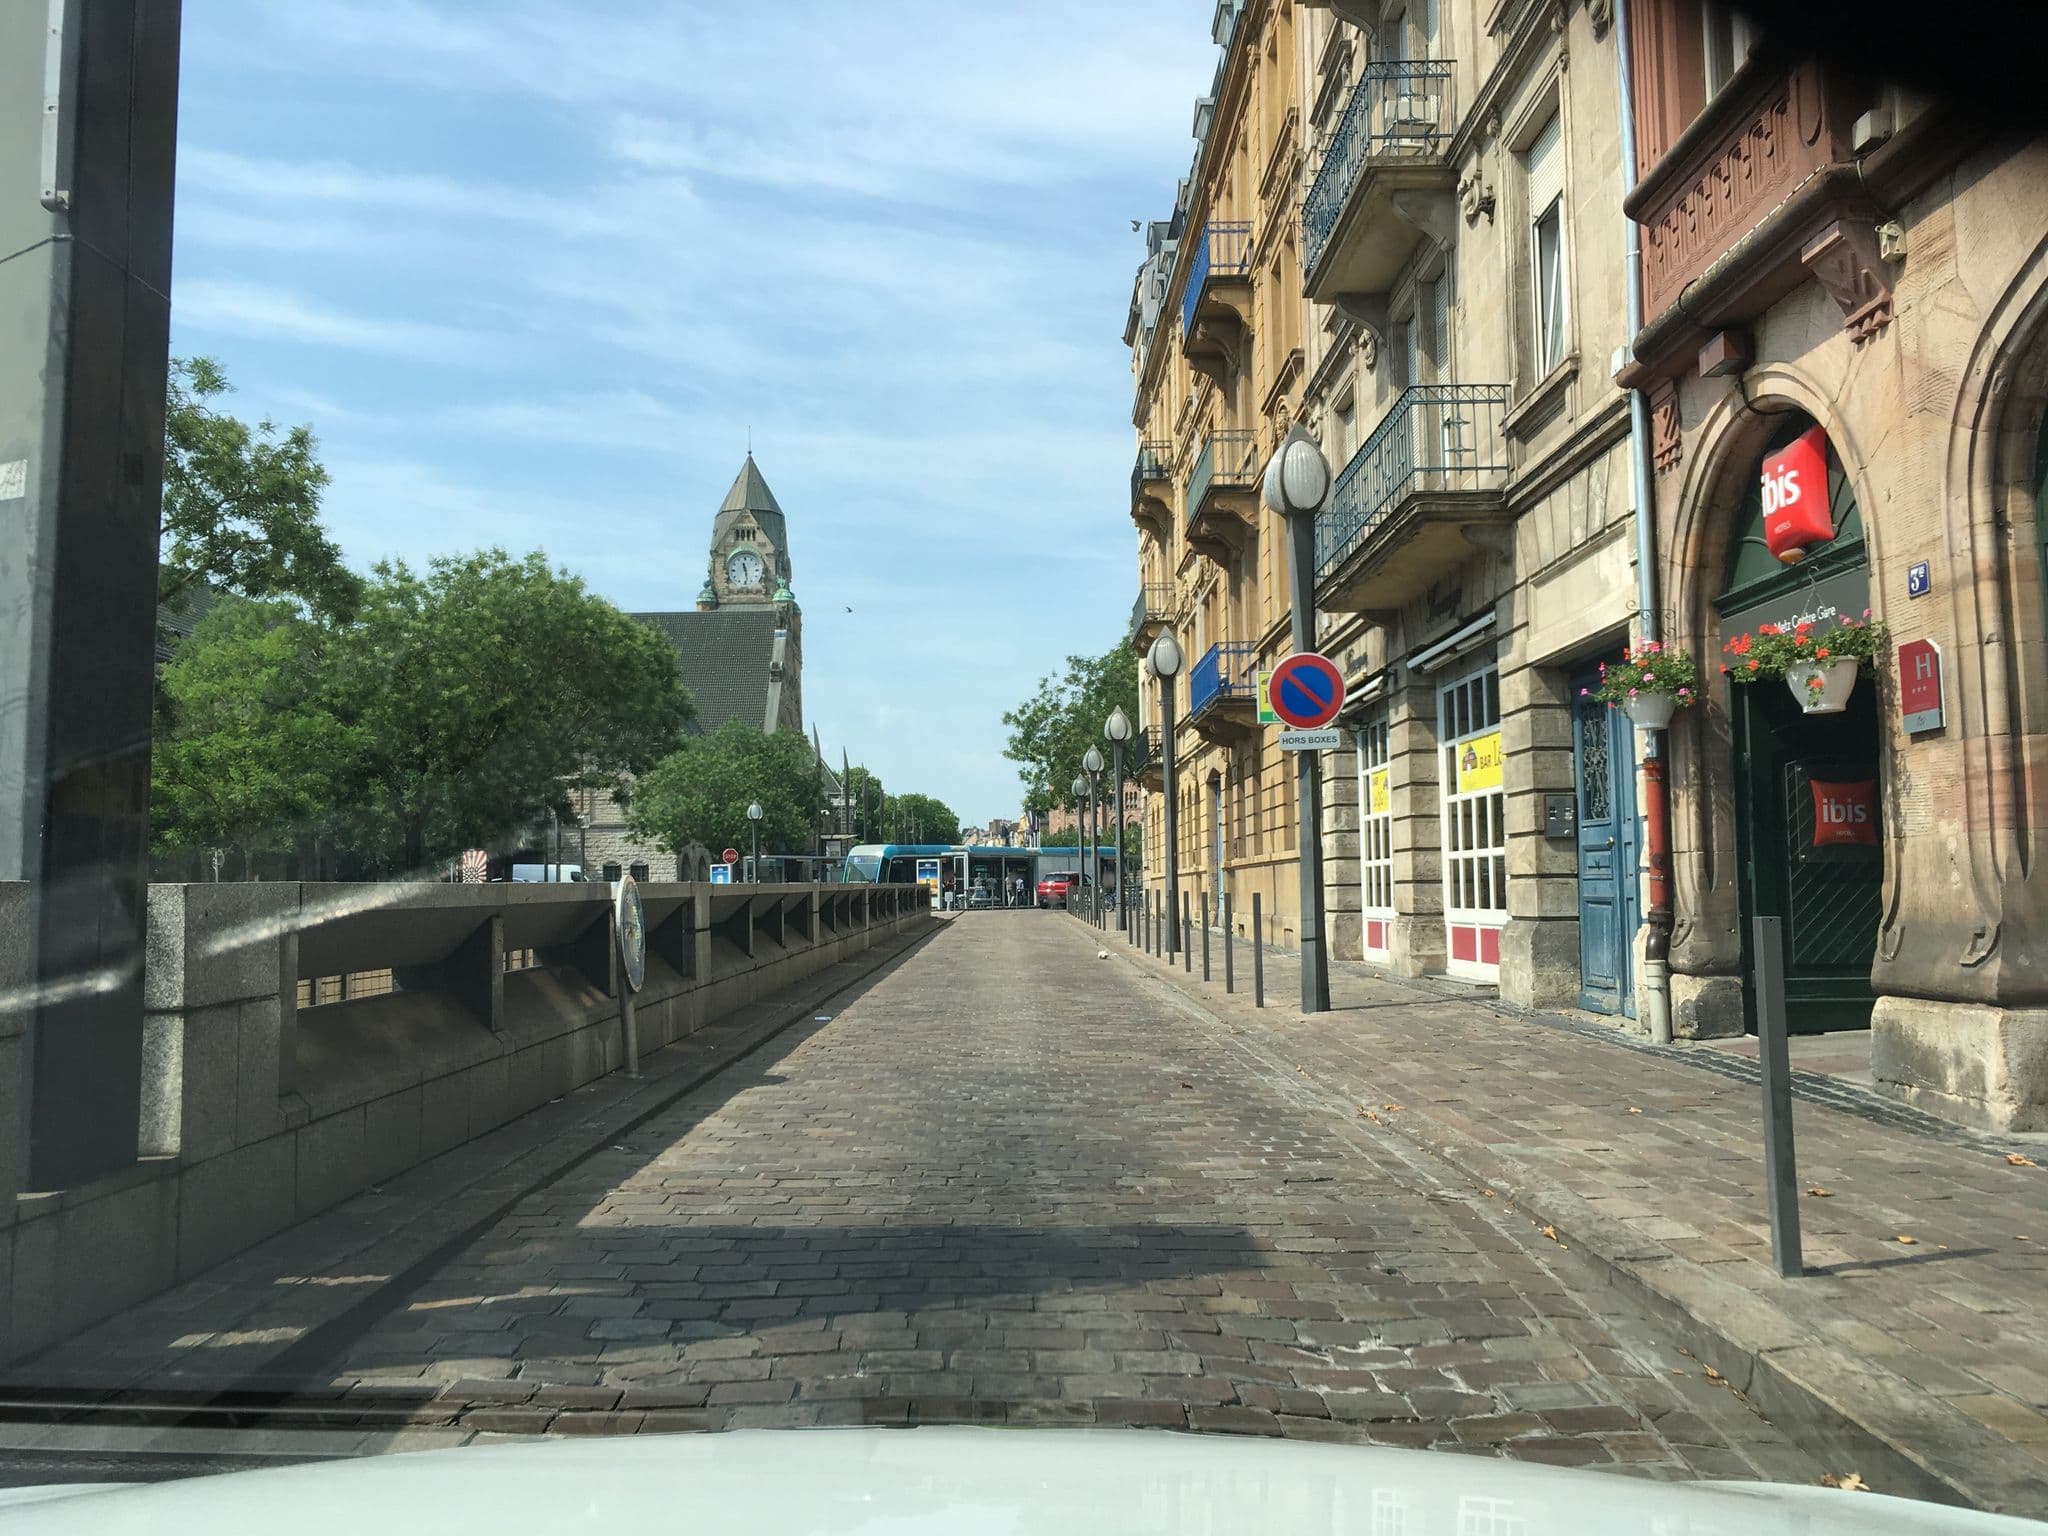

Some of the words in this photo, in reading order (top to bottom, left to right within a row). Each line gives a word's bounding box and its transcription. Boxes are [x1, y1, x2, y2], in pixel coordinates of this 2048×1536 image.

[1761, 464, 1801, 518] ibis
[1791, 612, 1817, 629] Centre
[1816, 605, 1837, 620] Gare
[1915, 652, 1932, 681] H
[1282, 736, 1306, 745] HORS
[1308, 735, 1338, 744] BOXES
[1822, 798, 1867, 823] ibis
